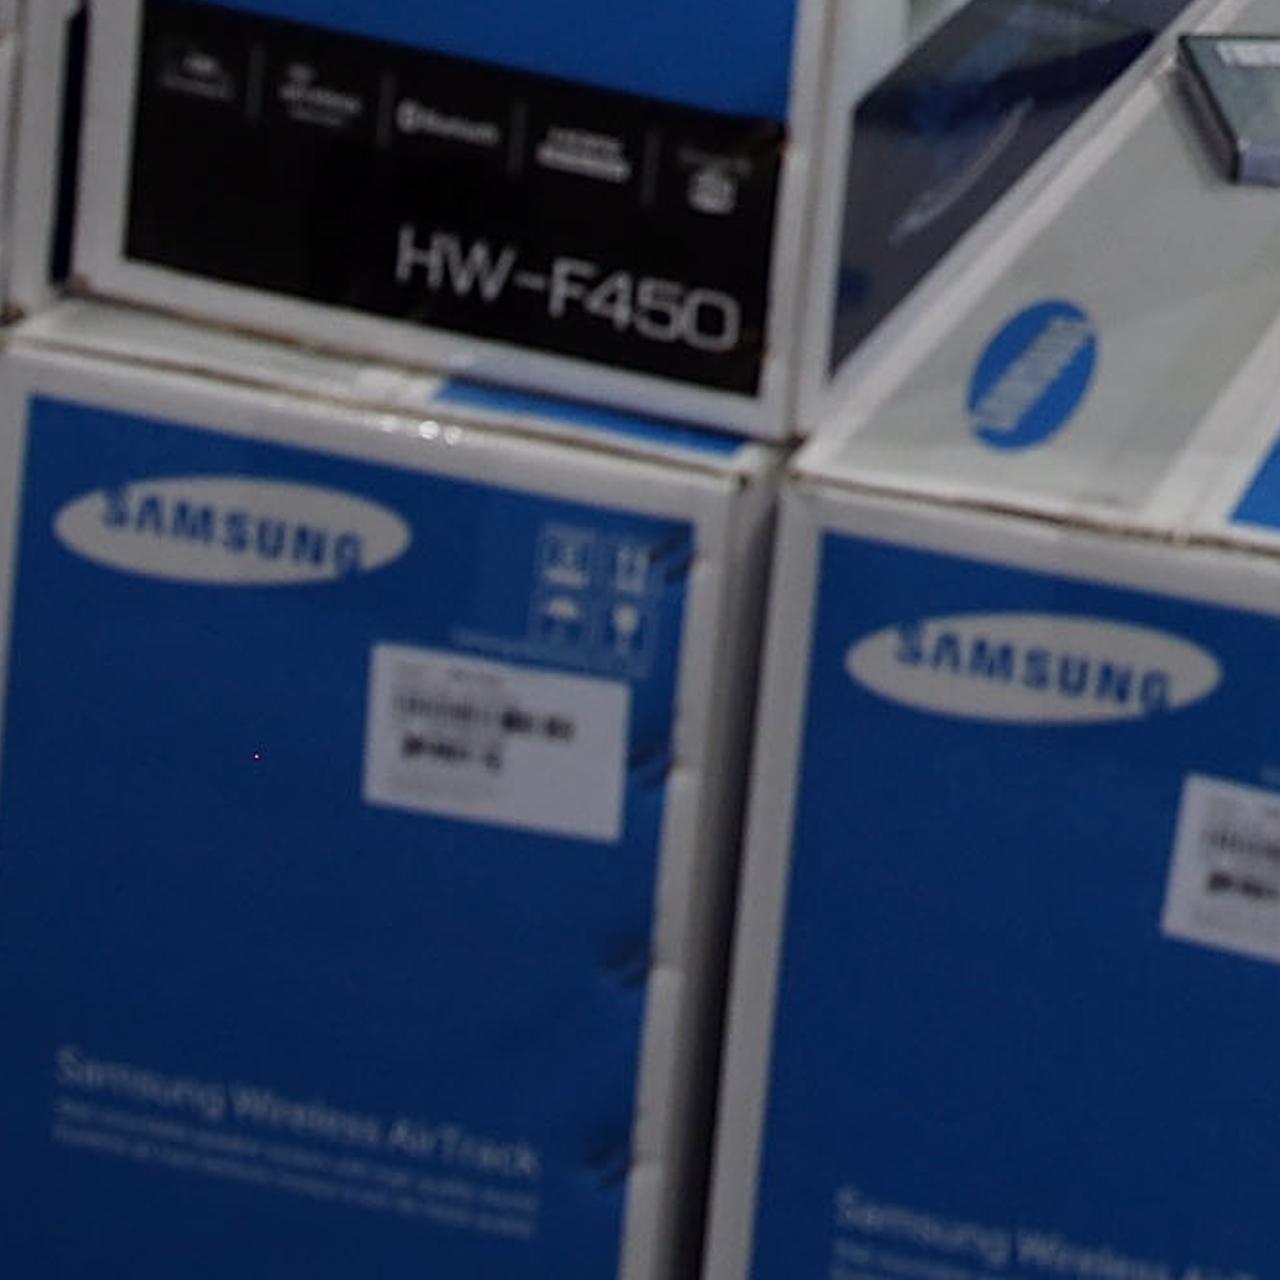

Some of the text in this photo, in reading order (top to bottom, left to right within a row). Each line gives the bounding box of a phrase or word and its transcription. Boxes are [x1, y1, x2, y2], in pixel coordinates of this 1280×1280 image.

[395, 224, 744, 354] HW-F450
[102, 490, 368, 580] SAMSUNG
[893, 618, 1175, 716] SAMSUNG
